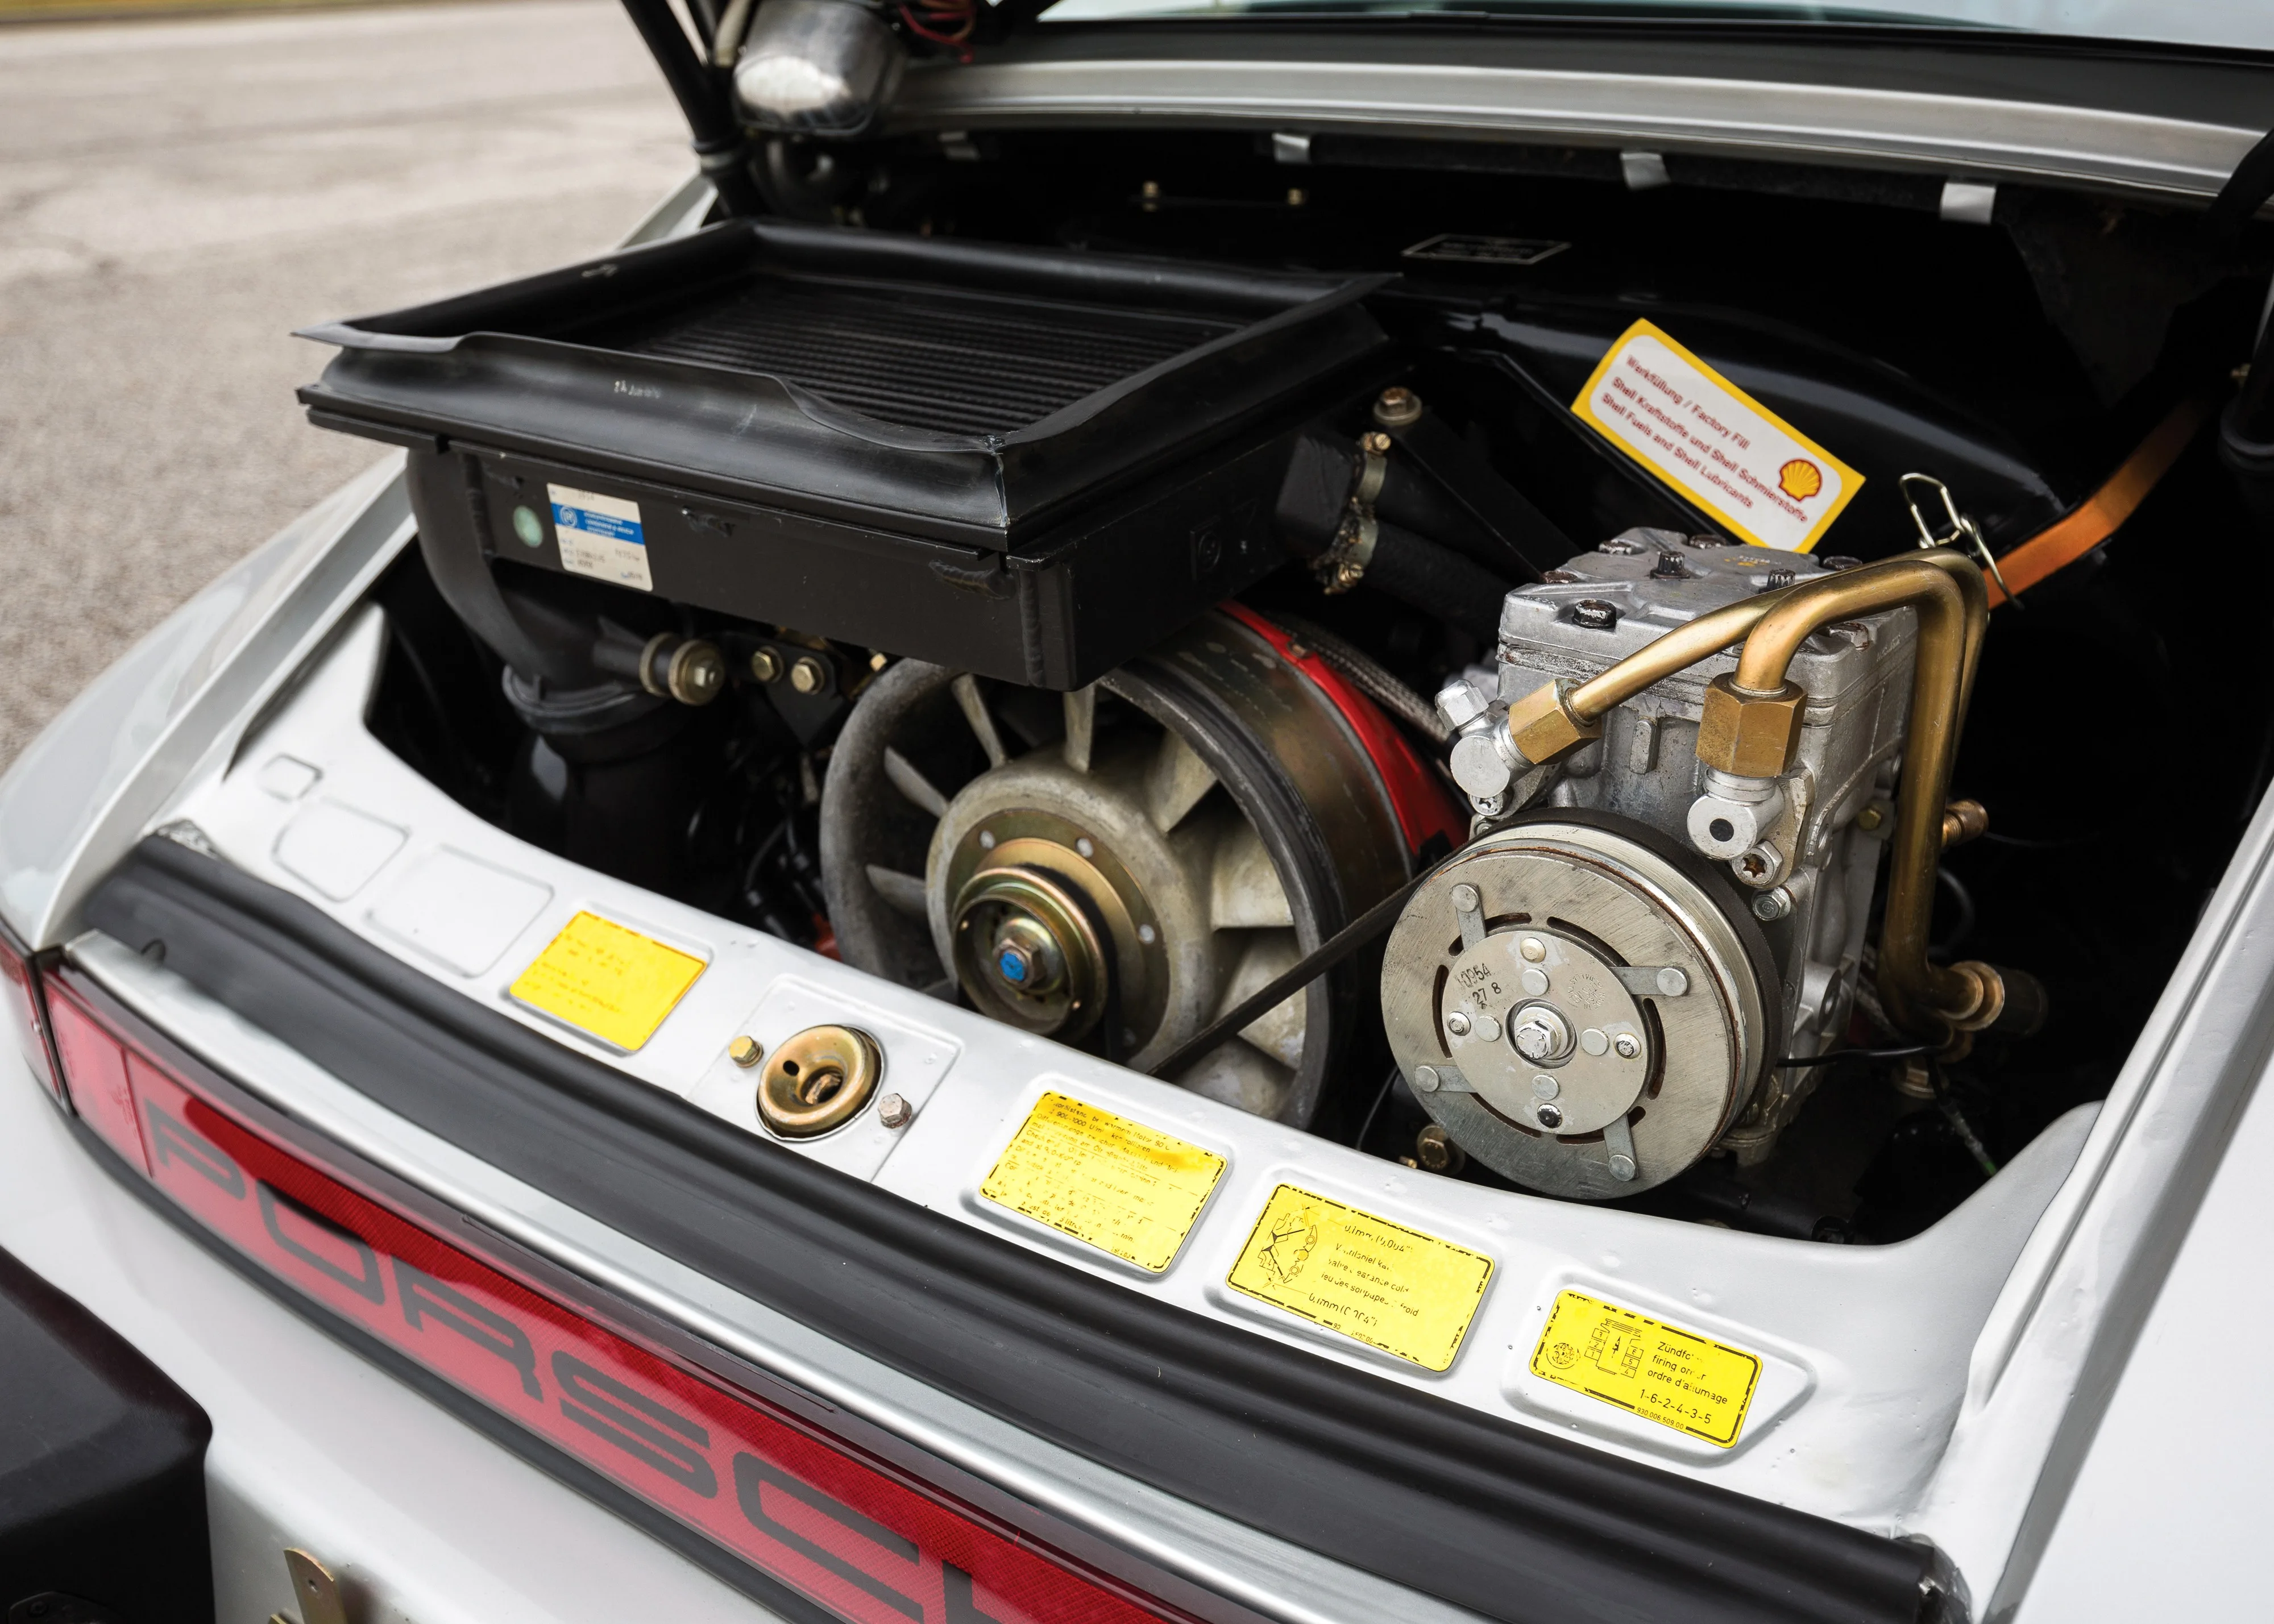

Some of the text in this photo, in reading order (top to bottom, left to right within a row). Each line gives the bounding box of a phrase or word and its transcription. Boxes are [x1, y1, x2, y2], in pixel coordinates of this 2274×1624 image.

[1626, 355, 1683, 405] Werkfüllung
[1691, 404, 1731, 438] Factory
[1731, 432, 1750, 450] Fill
[1601, 392, 1753, 508] Shell Fuels and Shell Lubricants
[1612, 376, 1808, 522] Shell Kraftstoffe und Shell Schmierstoffe
[1491, 982, 1501, 994] 8
[1648, 1370, 1672, 1383] ordre
[1653, 1355, 1706, 1380] firing orr
[1641, 1389, 1711, 1423] 1-6-2-4-3-5
